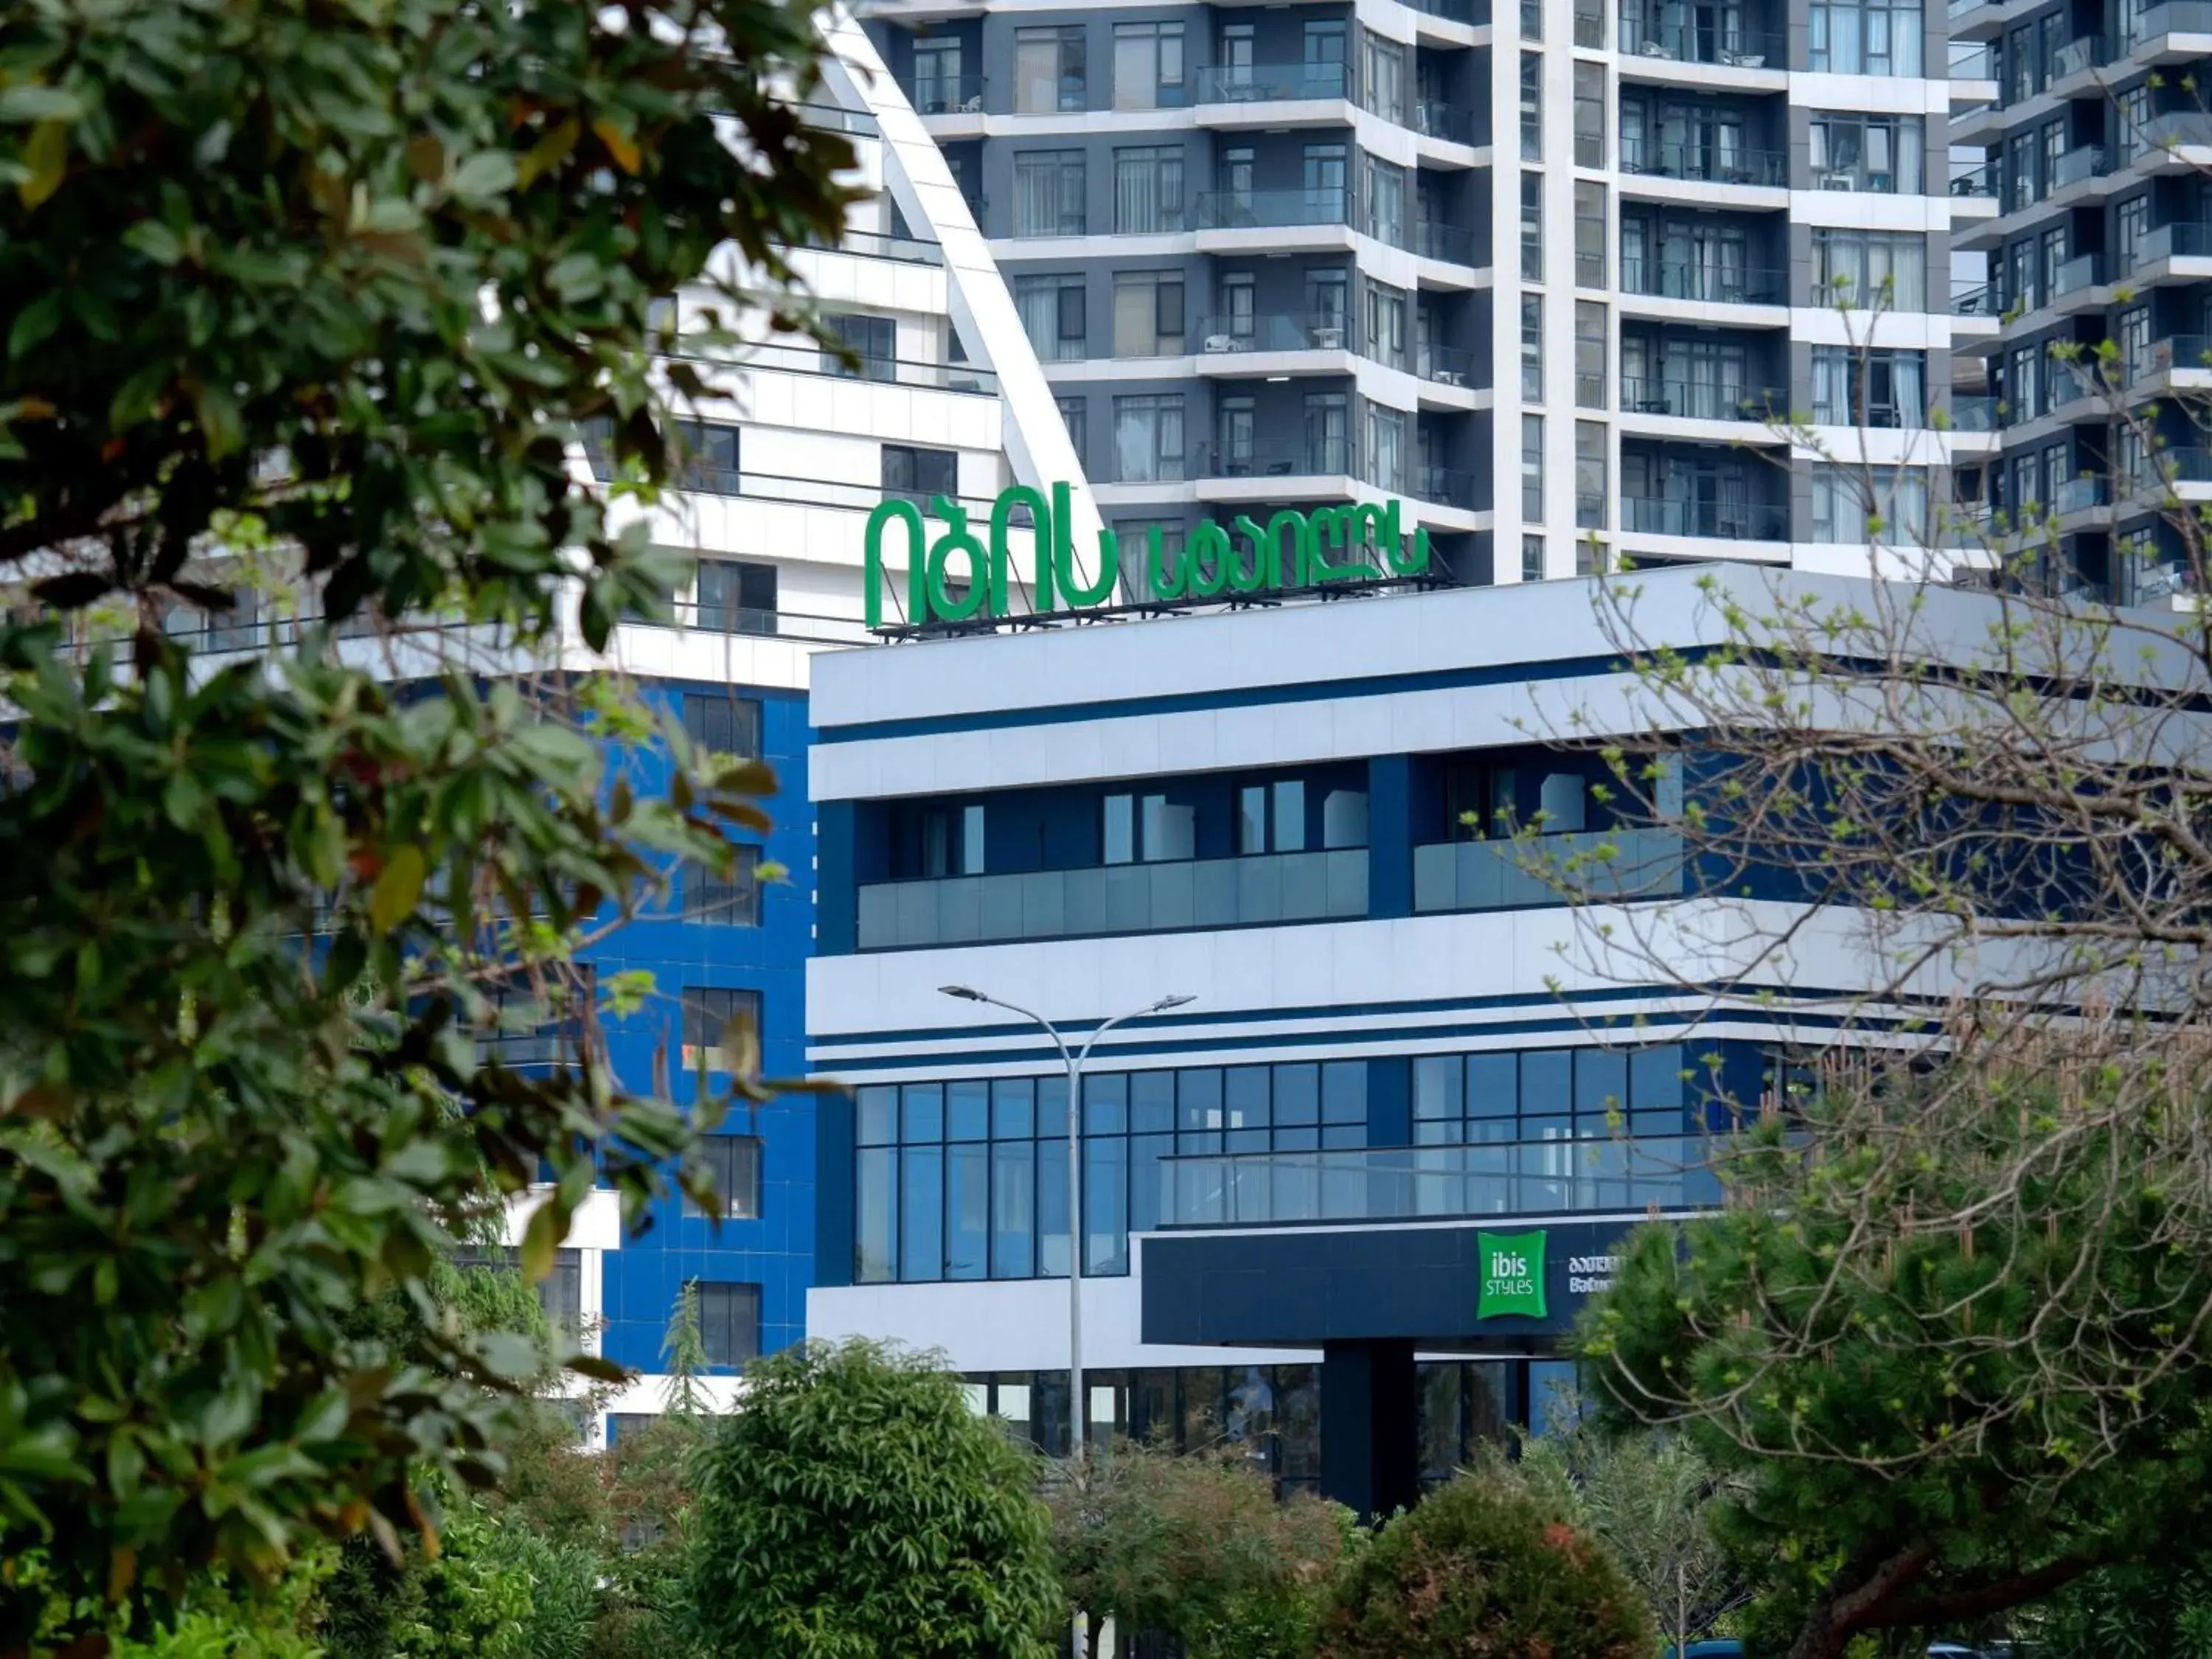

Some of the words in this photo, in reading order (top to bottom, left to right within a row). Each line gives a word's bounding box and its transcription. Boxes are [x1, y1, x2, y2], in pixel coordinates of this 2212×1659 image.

[865, 481, 1116, 628] იბის
[1148, 499, 1430, 601] სტაილს
[1492, 1252, 1527, 1278] ibis
